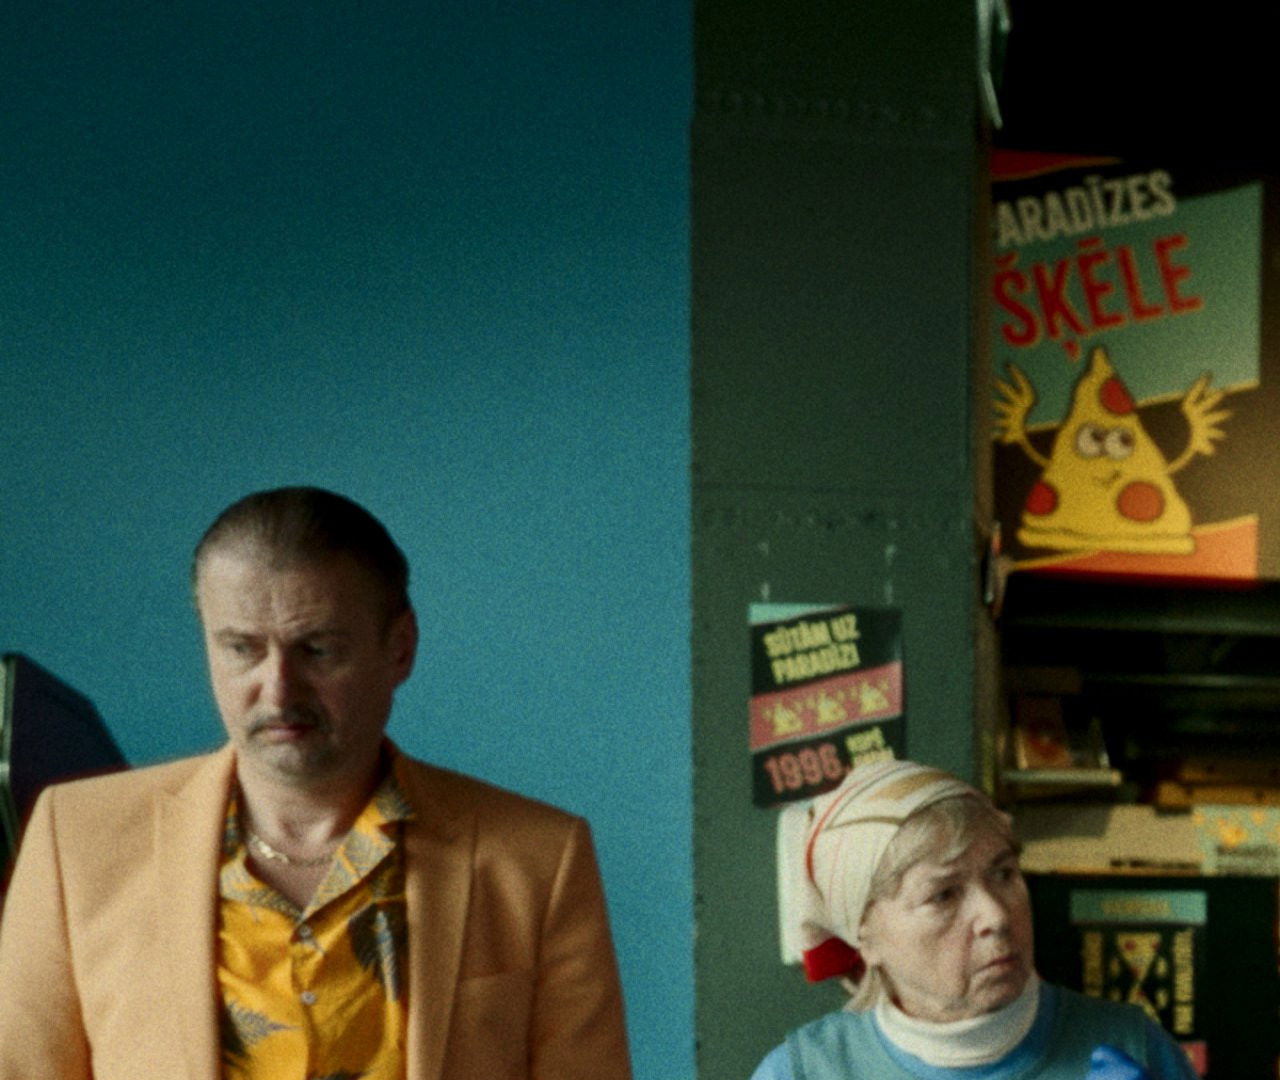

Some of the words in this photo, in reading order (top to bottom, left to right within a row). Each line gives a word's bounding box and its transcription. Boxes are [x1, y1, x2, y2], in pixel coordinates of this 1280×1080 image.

[997, 169, 1177, 248] ARADĪZES
[993, 234, 1205, 361] ŠĶĒLE
[831, 613, 861, 641] UZ
